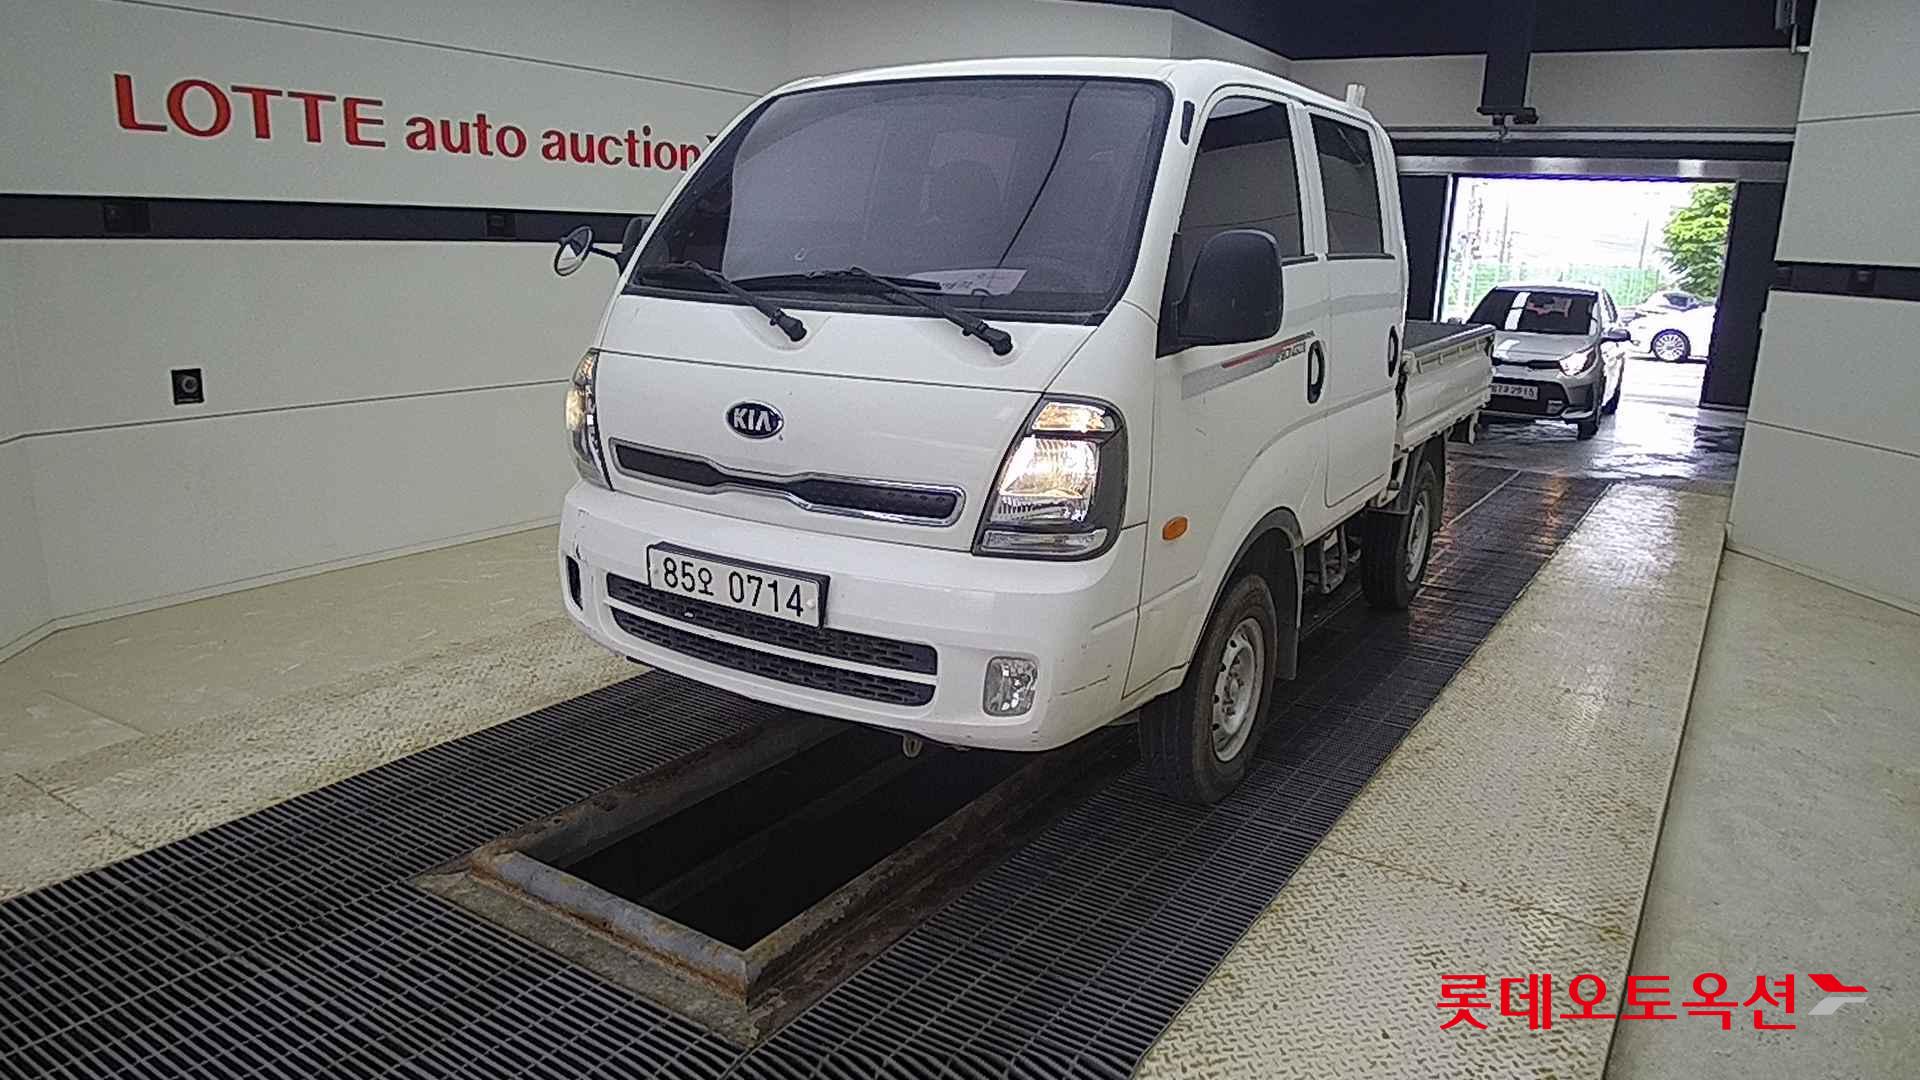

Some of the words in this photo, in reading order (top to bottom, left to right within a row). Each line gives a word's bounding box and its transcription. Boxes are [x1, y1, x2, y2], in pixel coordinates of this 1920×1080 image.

[113, 73, 387, 149] LOTTE
[405, 111, 527, 159] auto
[541, 125, 702, 172] auction
[733, 407, 772, 432] KIA
[662, 557, 714, 597] 85오
[728, 571, 804, 617] 0714
